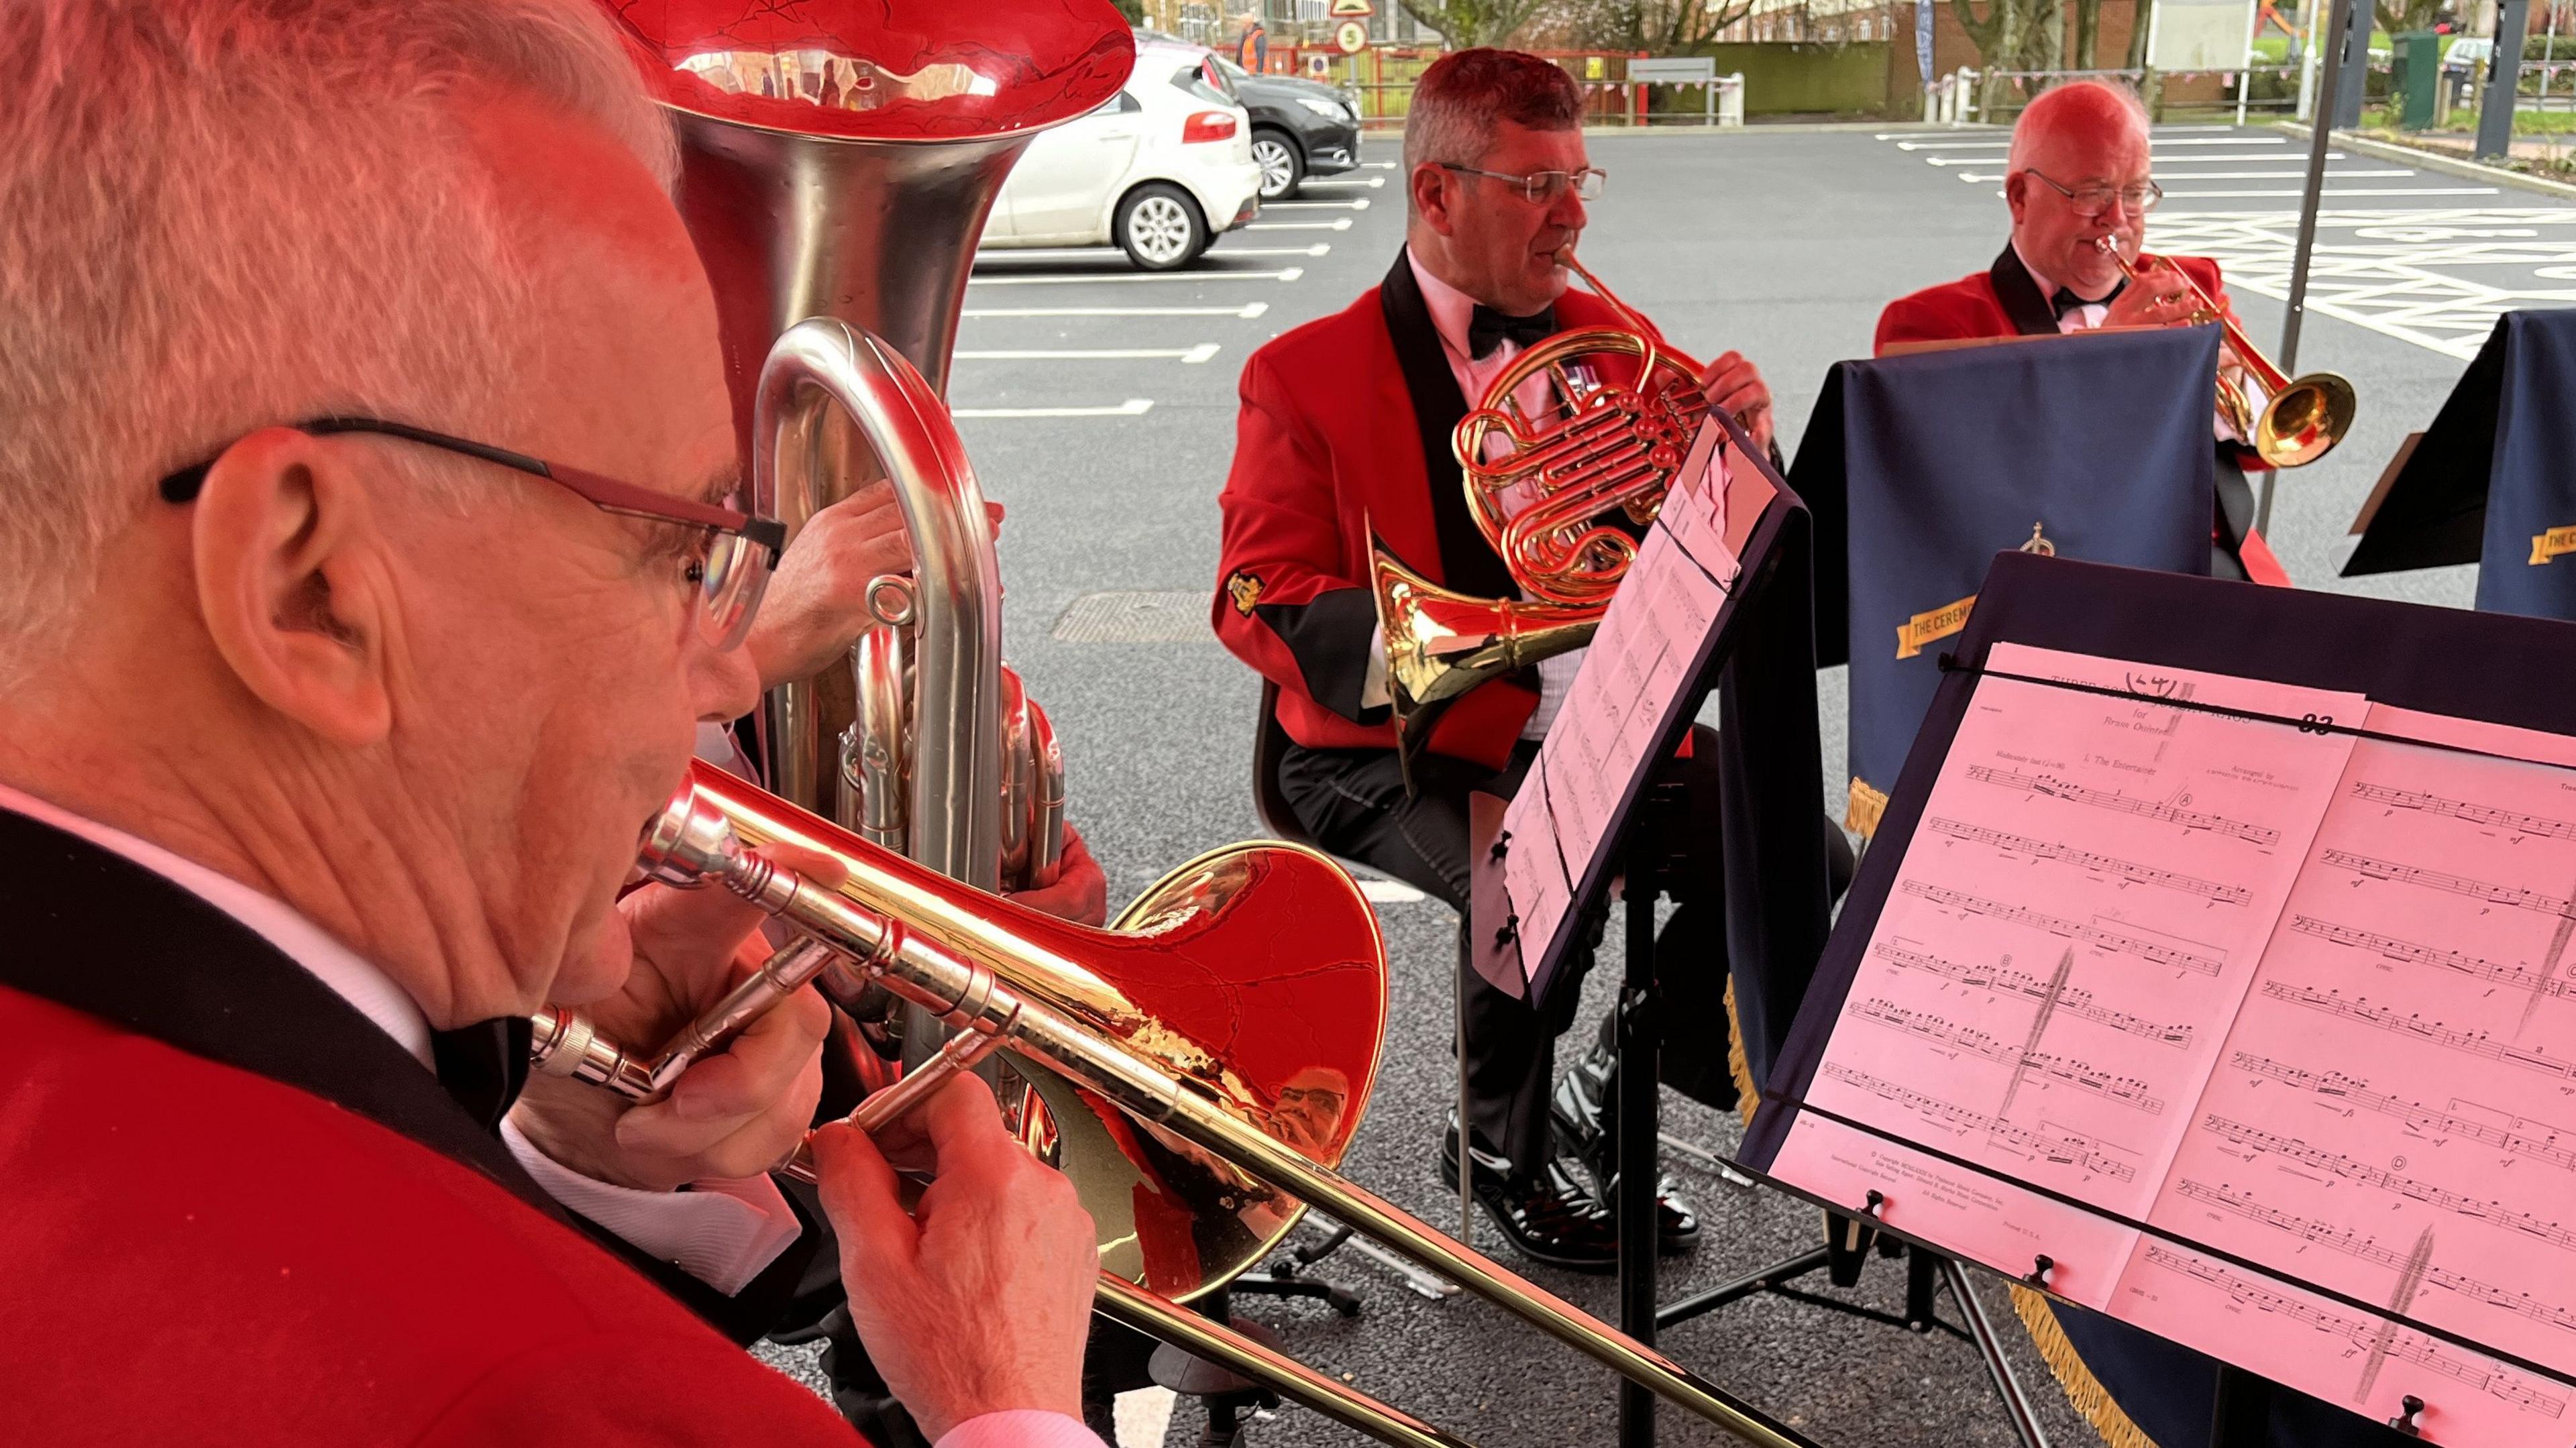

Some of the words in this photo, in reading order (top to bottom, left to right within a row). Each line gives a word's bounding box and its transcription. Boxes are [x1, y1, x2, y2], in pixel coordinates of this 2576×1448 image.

[1914, 619, 1932, 637] THE
[2133, 708, 2148, 719] for
[2104, 716, 2129, 728] Brass
[2095, 756, 2109, 766] The
[2112, 759, 2157, 775] Entertainer
[2232, 765, 2263, 777] Arranged
